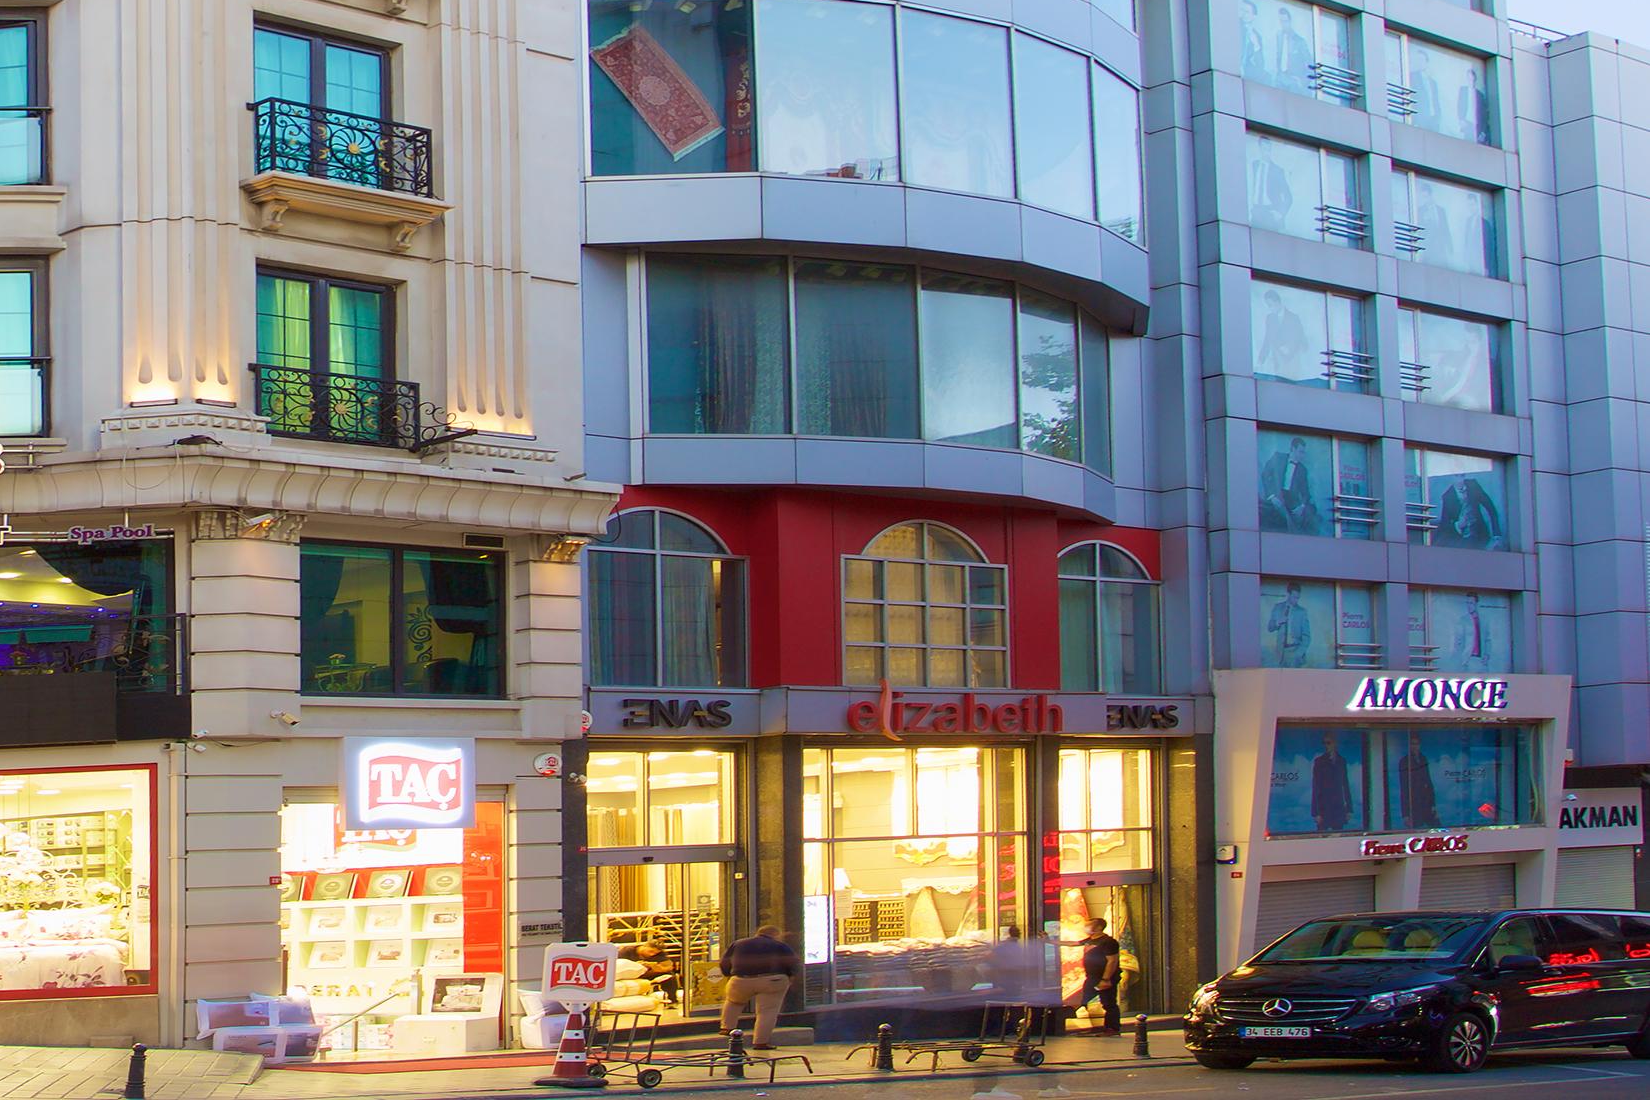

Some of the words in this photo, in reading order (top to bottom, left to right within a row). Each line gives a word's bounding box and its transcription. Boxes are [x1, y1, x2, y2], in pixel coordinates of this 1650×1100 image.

[70, 524, 105, 545] Spa
[110, 524, 154, 540] Pool
[1352, 677, 1509, 710] AMONCE
[622, 699, 732, 729] ENAS
[847, 678, 1064, 741] elizabeth
[1106, 704, 1180, 731] ENAS
[371, 763, 457, 811] TAÇ
[1558, 805, 1638, 830] AKMAN
[554, 962, 605, 988] TAÇ
